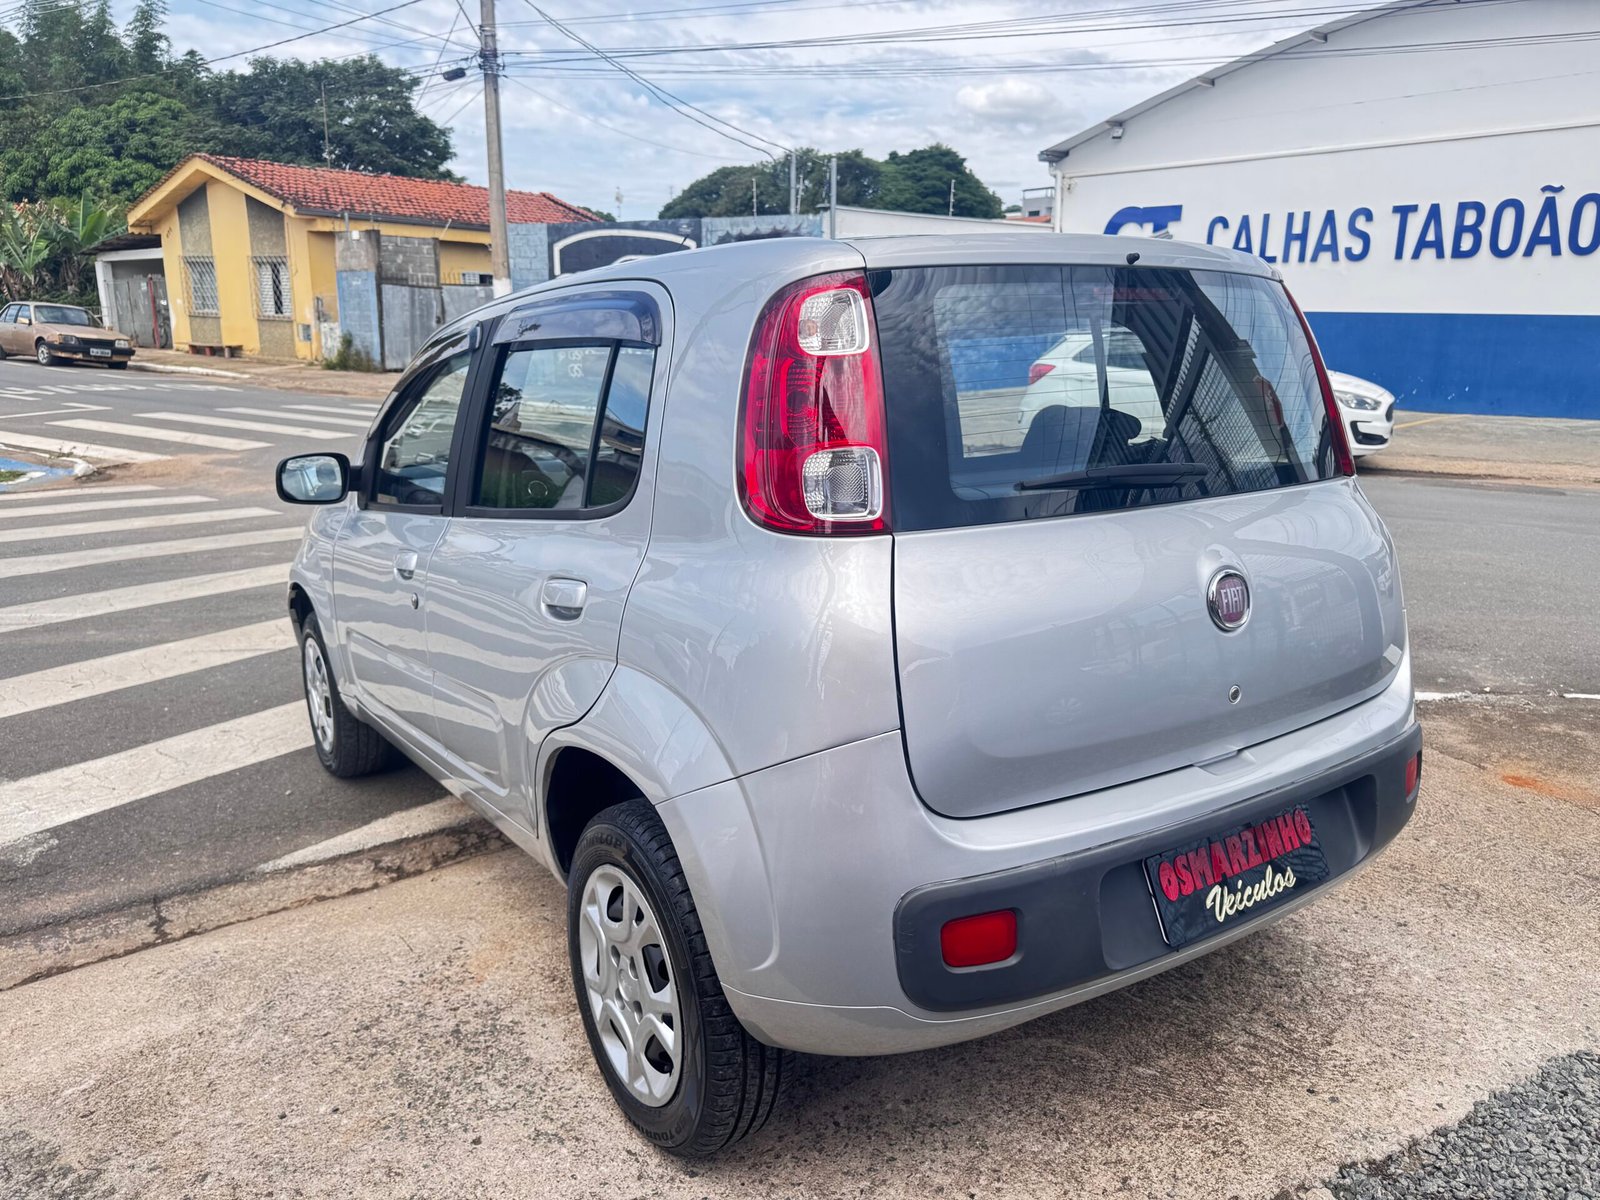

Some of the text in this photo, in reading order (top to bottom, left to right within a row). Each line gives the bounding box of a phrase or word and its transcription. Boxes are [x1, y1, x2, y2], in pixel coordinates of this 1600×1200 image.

[1206, 184, 1600, 263] CALHAS TABOÃO
[1220, 586, 1243, 615] FIAT
[1158, 807, 1312, 902] OSMARZINHO
